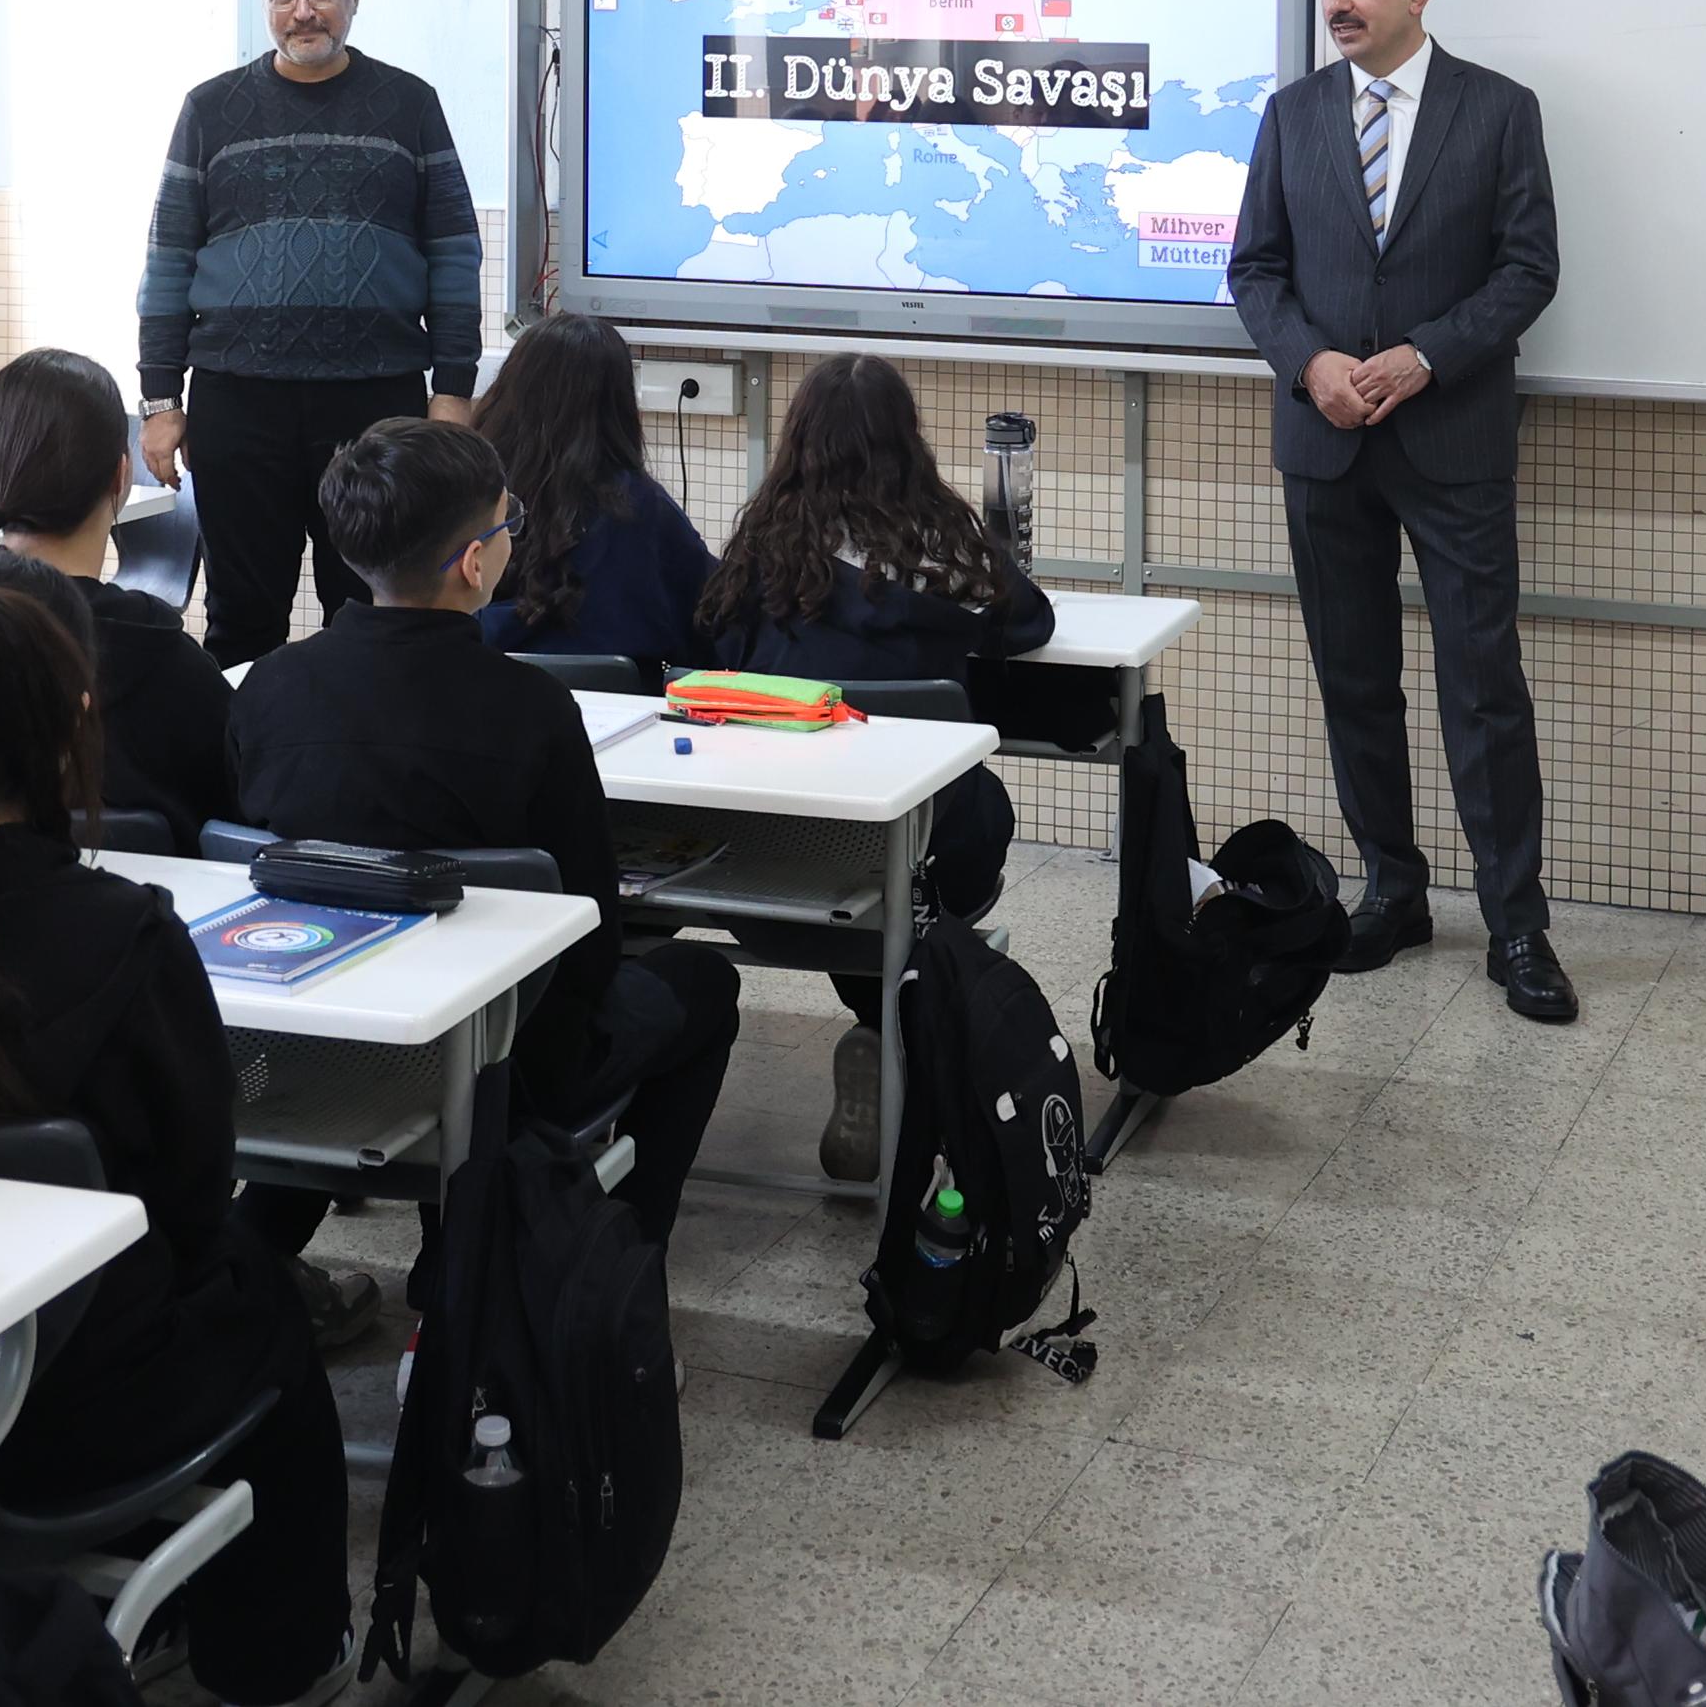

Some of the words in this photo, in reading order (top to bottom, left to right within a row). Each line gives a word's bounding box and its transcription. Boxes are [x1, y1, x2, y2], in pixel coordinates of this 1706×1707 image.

[703, 53, 765, 98] II.
[783, 54, 956, 112] Dünya
[972, 58, 1149, 117] Savaşı
[913, 148, 957, 164] Rome
[1150, 216, 1225, 236] Mihver
[1150, 245, 1233, 265] Müttefi
[901, 301, 926, 309] VESTEL
